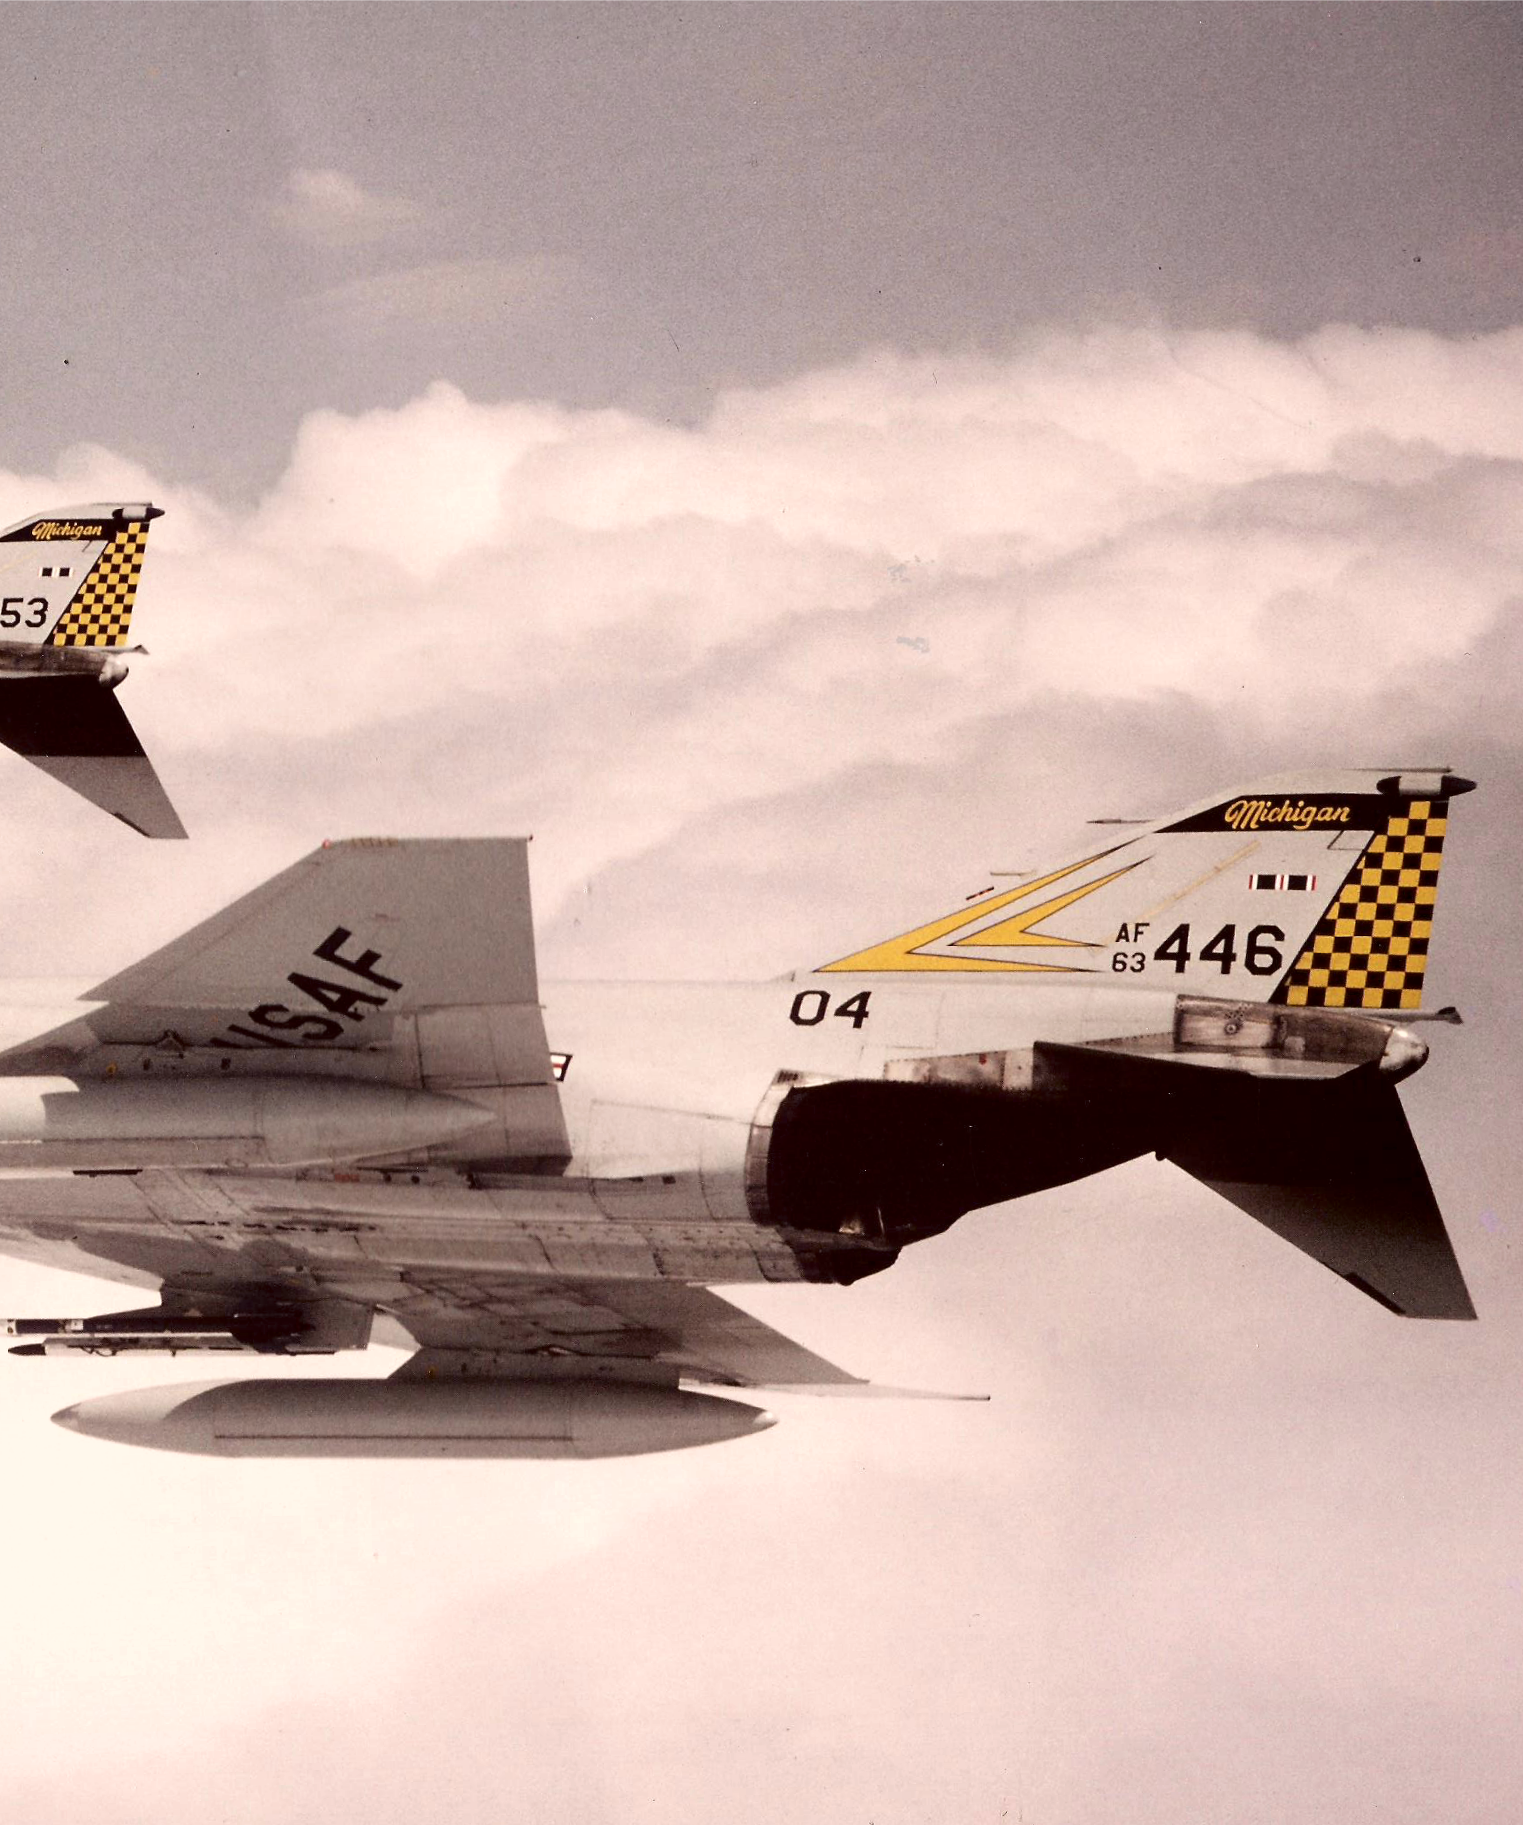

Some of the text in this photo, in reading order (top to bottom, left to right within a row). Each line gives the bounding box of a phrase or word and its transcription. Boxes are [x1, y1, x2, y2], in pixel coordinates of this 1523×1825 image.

[32, 521, 102, 540] Michigan
[1224, 799, 1351, 830] Michigan
[1114, 922, 1150, 943] AF
[1111, 951, 1146, 973] 63
[1153, 923, 1286, 976] 446
[789, 990, 872, 1029] 04
